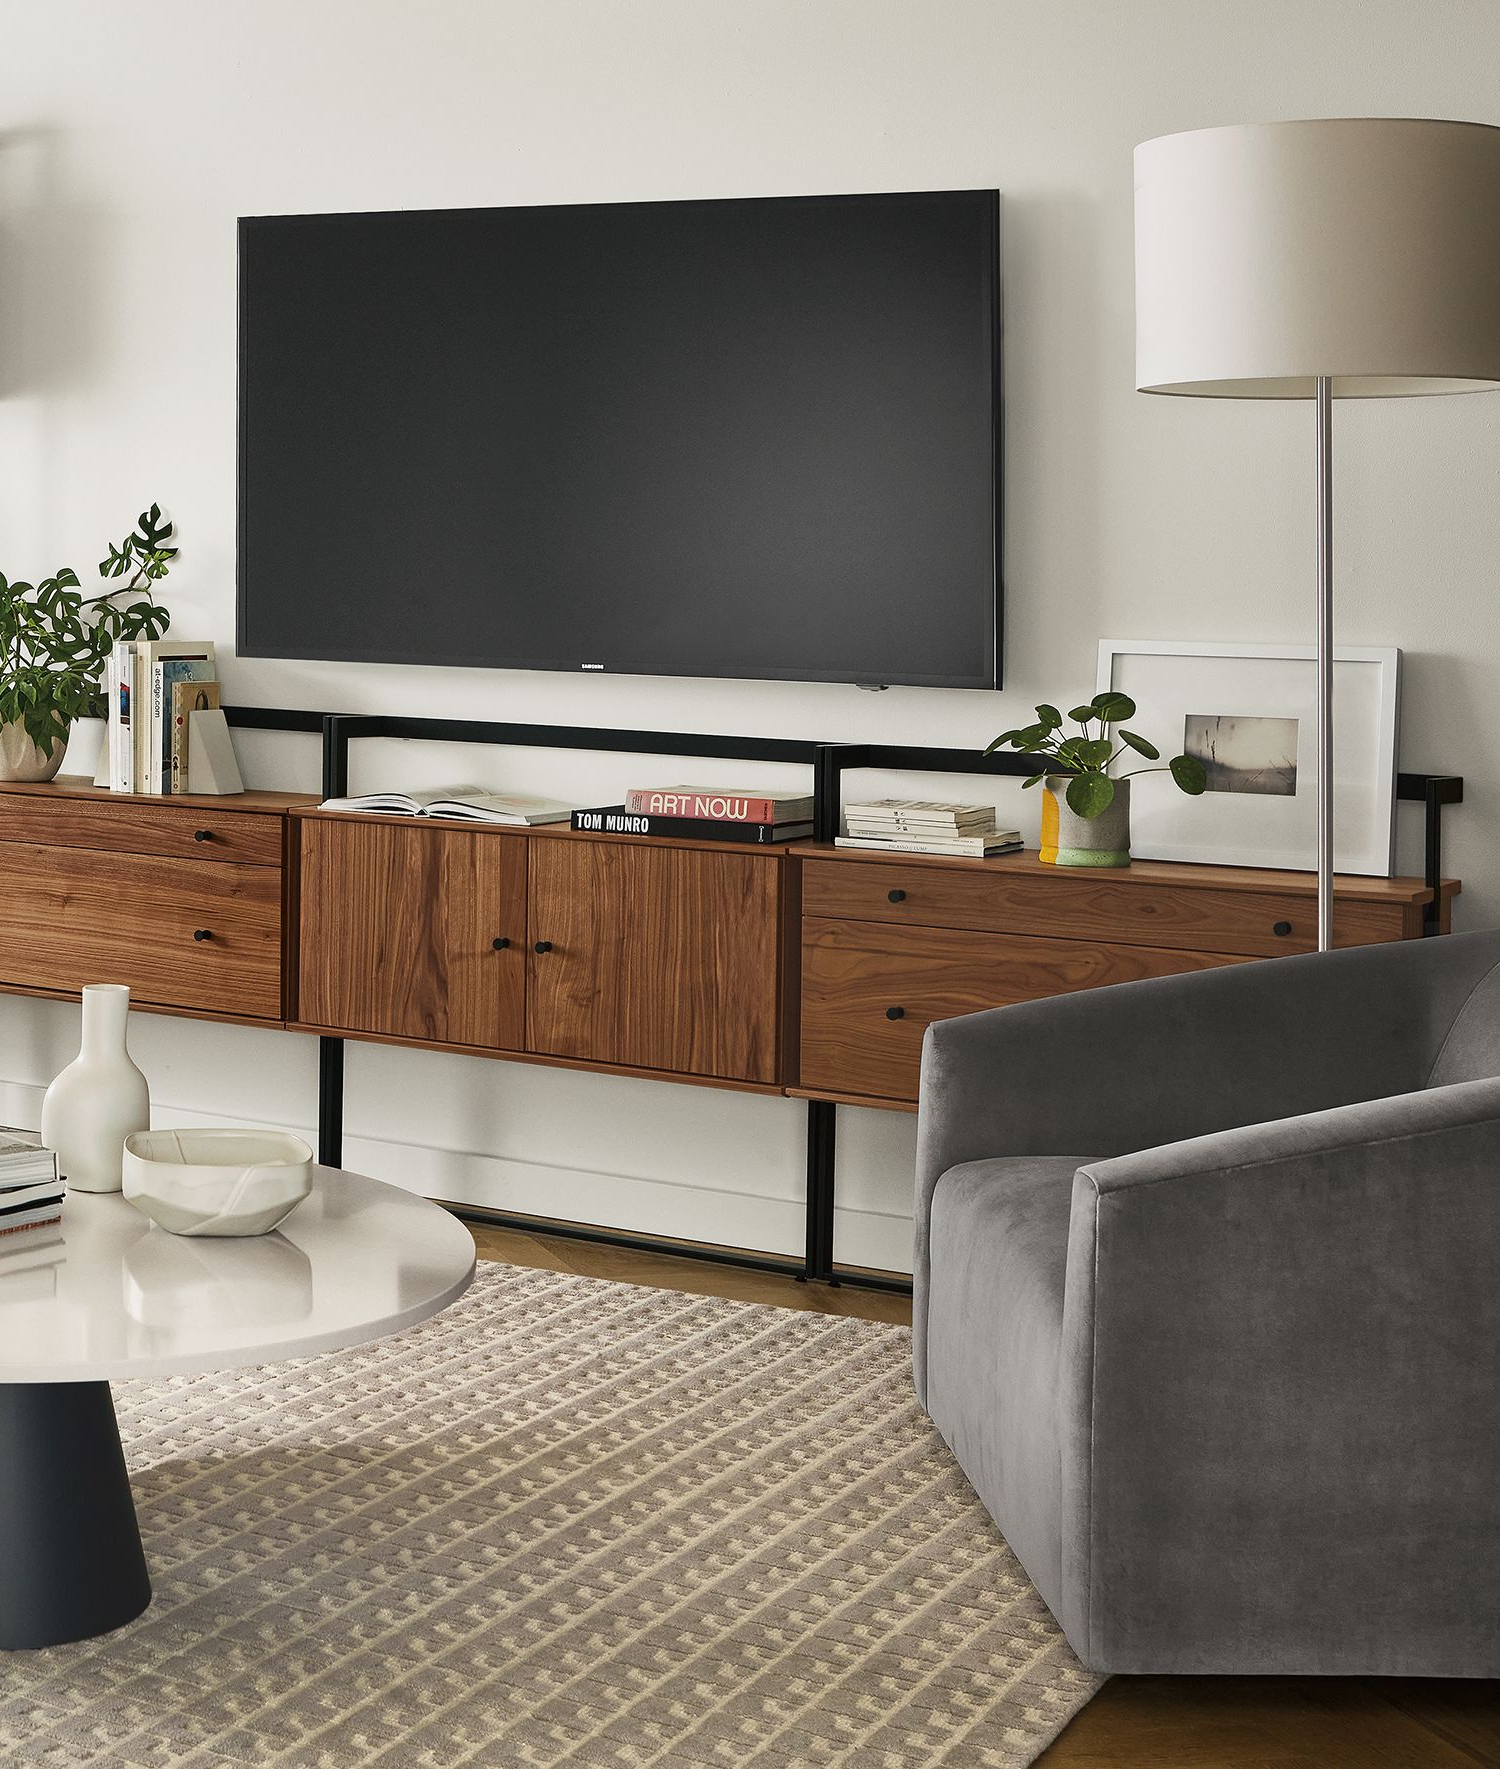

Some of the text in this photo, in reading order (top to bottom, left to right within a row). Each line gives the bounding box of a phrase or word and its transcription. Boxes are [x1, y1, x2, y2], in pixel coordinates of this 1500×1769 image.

[153, 668, 162, 718] at-edge.com
[648, 793, 691, 815] ART
[694, 796, 749, 820] NOW
[577, 813, 649, 833] TOM MUNRO
